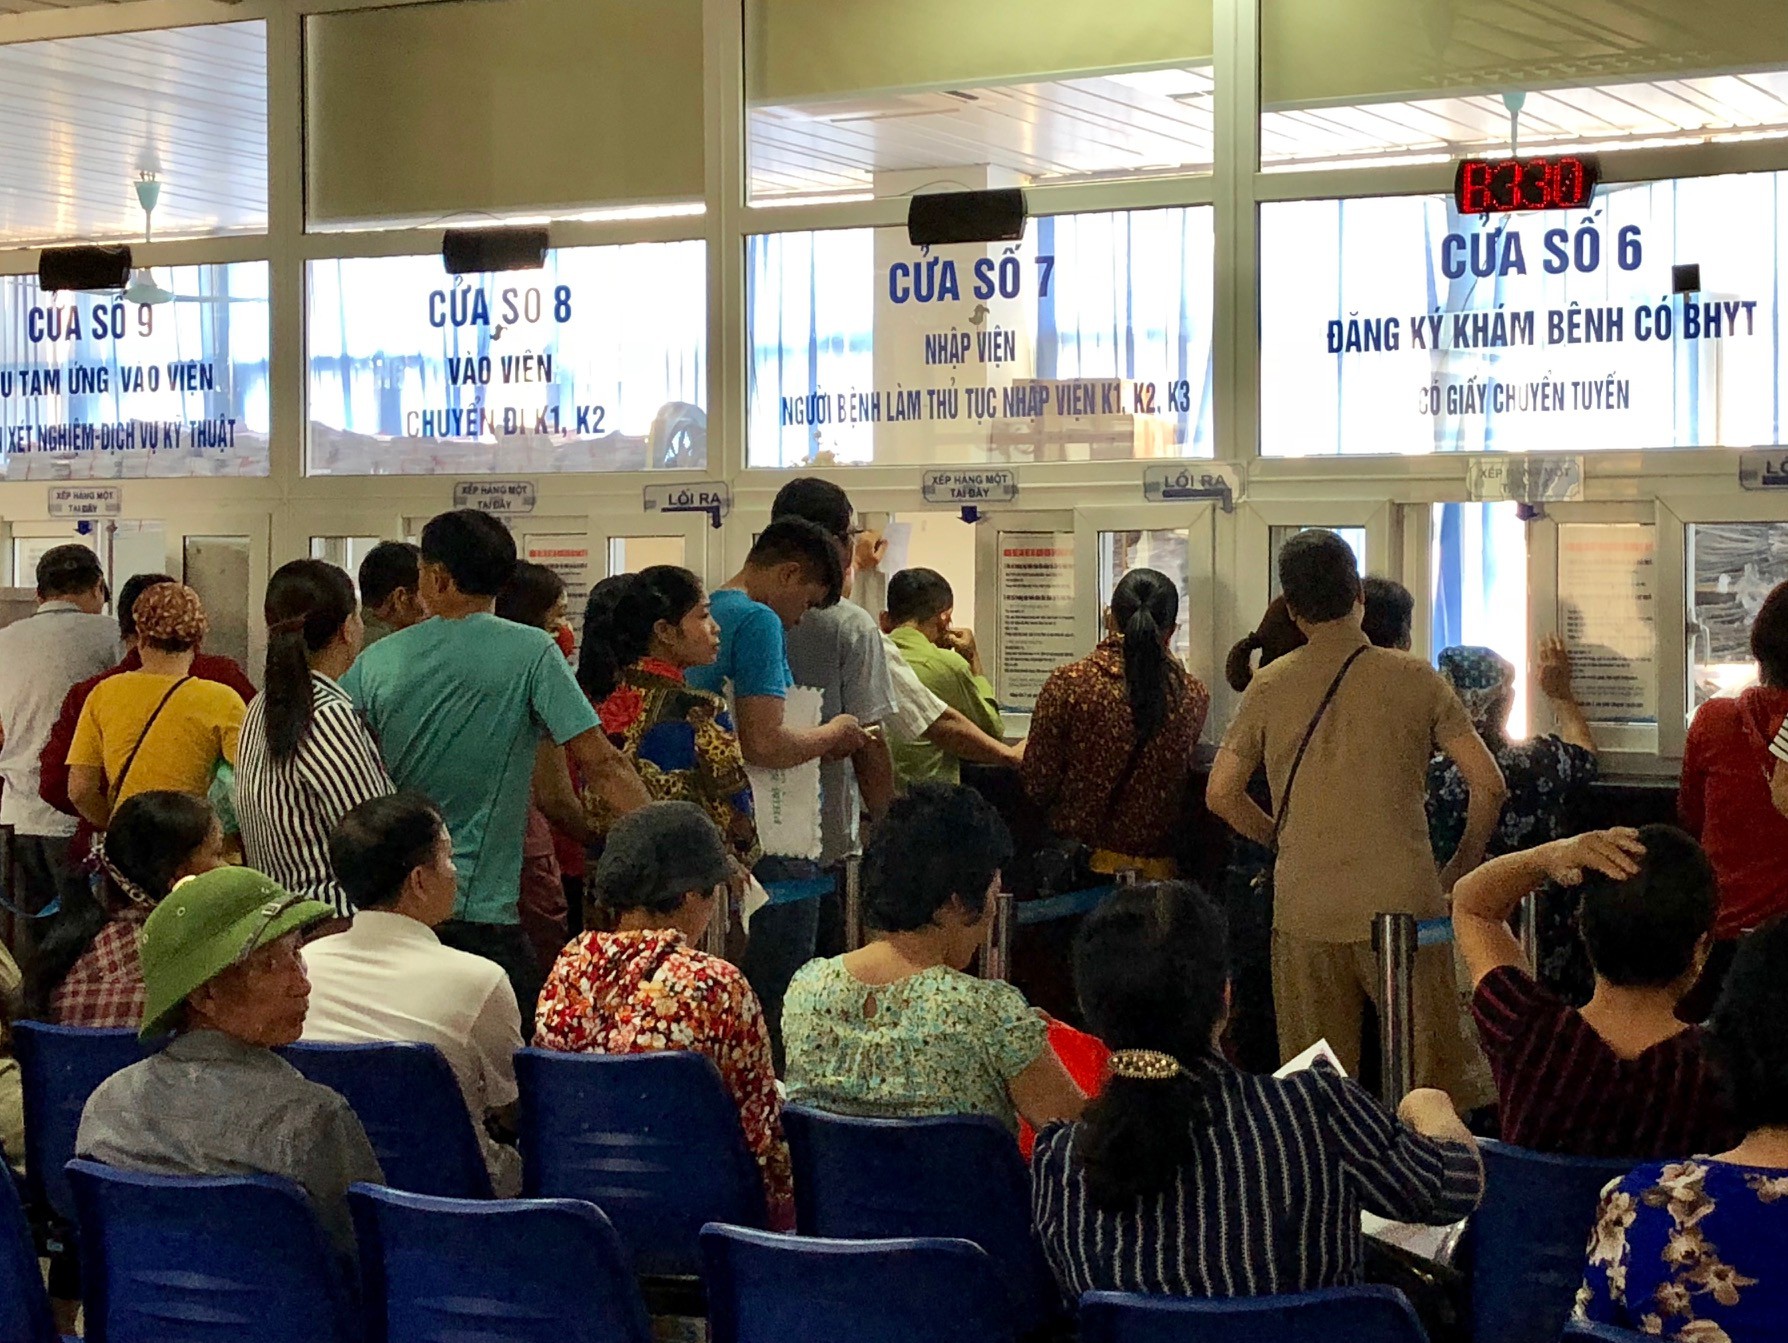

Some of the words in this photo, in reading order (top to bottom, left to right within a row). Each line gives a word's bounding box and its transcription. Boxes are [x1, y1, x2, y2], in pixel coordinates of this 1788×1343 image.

[1441, 212, 1527, 279] CỬA
[1542, 209, 1603, 274] SỐ
[1618, 224, 1642, 271] 6
[889, 244, 960, 304] CỬA
[973, 243, 1022, 300] SỐ
[1034, 255, 1055, 298] 7
[137, 303, 153, 338] 9
[428, 276, 490, 328] CỬA
[553, 284, 572, 323] 8
[1326, 310, 1400, 354] ĐĂNG
[1410, 306, 1443, 350] KÝ
[1453, 303, 1535, 348] KHÁM
[1634, 295, 1672, 341] CÓ
[1683, 300, 1758, 340] BHYT
[448, 350, 492, 386] VÀO
[925, 326, 971, 370] NHẬP
[976, 324, 1016, 369] VIỆN
[68, 360, 109, 395] ỨNG
[167, 358, 213, 396] VIỆN
[1447, 375, 1487, 416] GIẤY
[1493, 370, 1565, 414] CHUYỂN
[1571, 370, 1630, 411] TUYẾN
[406, 395, 495, 438] CHUYỂN
[503, 406, 525, 435] ĐI
[534, 405, 568, 437] K1,
[576, 405, 606, 434] K2
[781, 384, 832, 426] NGƯỜI
[837, 386, 881, 428] BỆNH
[886, 382, 922, 422] LÀM
[926, 376, 959, 420] THỦ
[965, 386, 997, 426] TỤC
[1003, 378, 1050, 424] NHẬP
[1055, 377, 1096, 422] VIỆN
[1168, 379, 1191, 413] K3
[8, 418, 33, 454] XÉT
[140, 420, 159, 455] VỤ
[189, 413, 236, 453] THUẬT
[699, 492, 722, 505] RA
